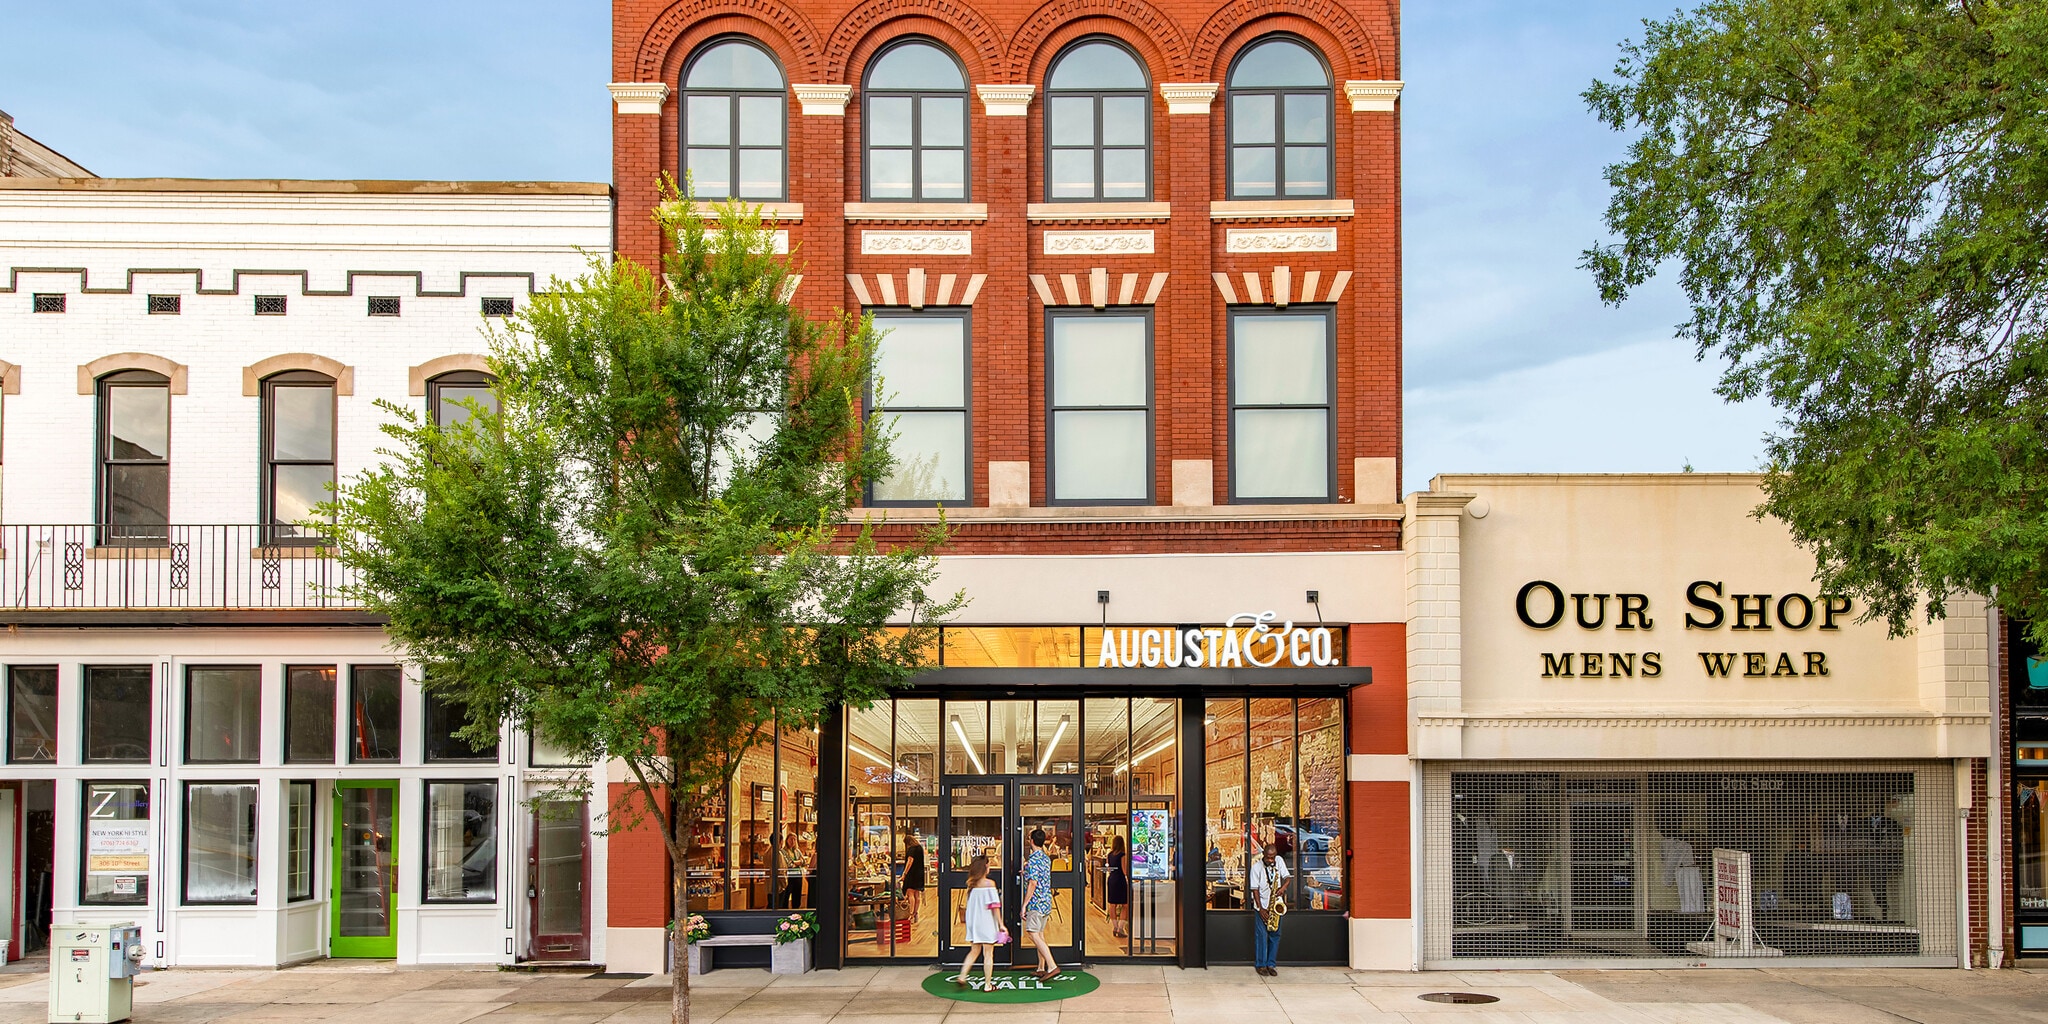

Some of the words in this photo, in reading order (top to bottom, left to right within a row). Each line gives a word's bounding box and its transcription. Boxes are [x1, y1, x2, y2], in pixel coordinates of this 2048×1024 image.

[1515, 580, 1654, 630] OUR
[1684, 580, 1853, 630] SHOP
[1098, 629, 1243, 668] AUGUSTA
[1225, 610, 1293, 668] &
[1290, 627, 1340, 667] CO.
[1541, 651, 1662, 678] MENS
[1698, 651, 1830, 678] WEAR
[90, 791, 117, 818] Z
[960, 836, 996, 847] AUGUSTA
[1718, 885, 1739, 906] SUIT
[1719, 908, 1741, 929] SALE
